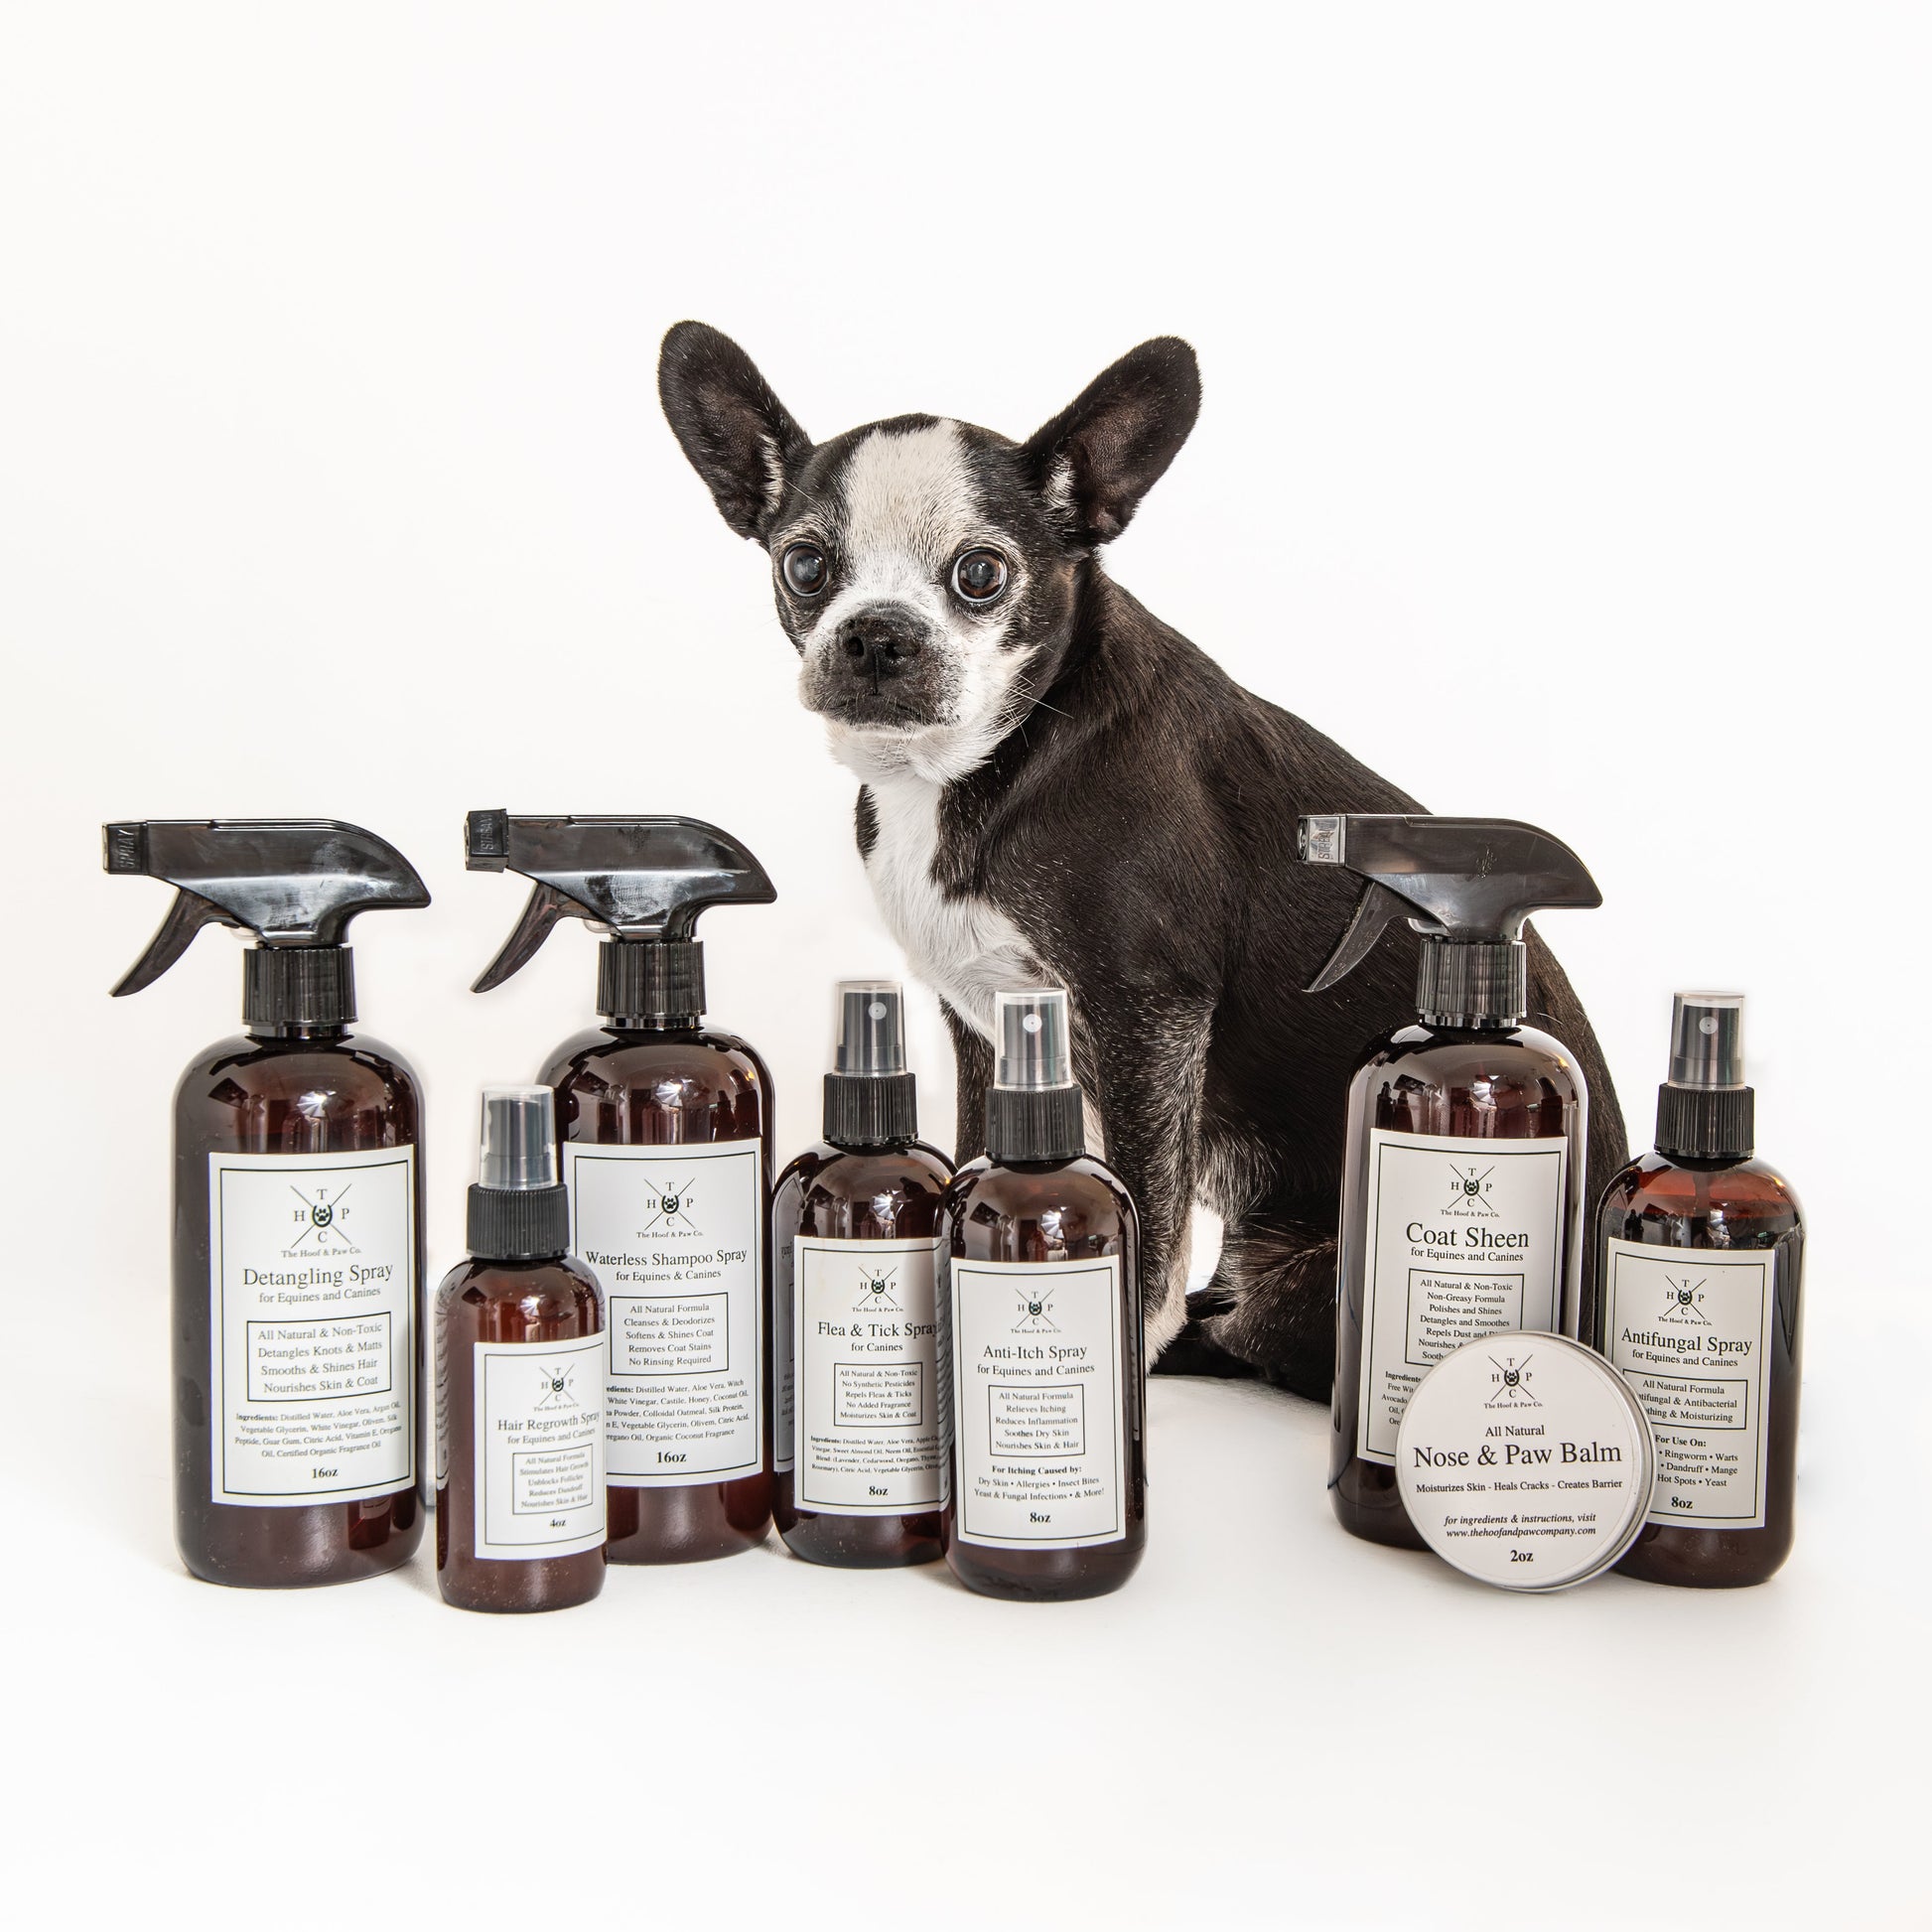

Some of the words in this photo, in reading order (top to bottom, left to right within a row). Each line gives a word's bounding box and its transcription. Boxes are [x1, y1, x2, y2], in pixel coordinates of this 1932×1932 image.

[118, 829, 135, 868] SPRAY
[1406, 1222, 1457, 1246] Coat
[1465, 1227, 1529, 1247] Sheen
[586, 1251, 647, 1266] Waterless
[651, 1254, 713, 1268] Shampoo
[716, 1249, 747, 1265] Spray
[1411, 1247, 1425, 1257] for
[1427, 1249, 1464, 1262] Equines
[1468, 1252, 1485, 1261] and
[243, 1268, 344, 1289] Detangling
[349, 1264, 393, 1282] Spray
[616, 1272, 631, 1281] for
[633, 1271, 670, 1283] Equines
[674, 1271, 682, 1281] &
[686, 1270, 722, 1280] Canines
[1434, 1280, 1462, 1290] Natural
[259, 1293, 273, 1304] for
[278, 1292, 320, 1305] Equines
[323, 1291, 341, 1301] and
[344, 1287, 380, 1300] Canines
[1428, 1293, 1472, 1304] Non-Greasy
[645, 1305, 674, 1313] Natural
[677, 1304, 709, 1312] Formula
[1429, 1305, 1460, 1313] Polishes
[672, 1316, 715, 1325] Deodorizes
[1420, 1315, 1457, 1325] Detangles
[258, 1330, 273, 1340] All
[277, 1329, 316, 1340] Natural
[320, 1328, 328, 1338] &
[333, 1323, 382, 1336] Non-Toxic
[818, 1321, 846, 1336] Flea
[851, 1324, 863, 1336] &
[868, 1323, 899, 1336] Tick
[688, 1342, 712, 1351] Stains
[867, 1342, 903, 1352] Canines
[1621, 1327, 1702, 1352] Antifungal
[1708, 1336, 1753, 1356] Spray
[258, 1347, 310, 1359] Detangles
[314, 1346, 343, 1356] Knots
[345, 1344, 354, 1353] &
[357, 1341, 382, 1352] Matts
[983, 1344, 1043, 1359] Anti-Itch
[1049, 1345, 1087, 1361] Spray
[643, 1357, 674, 1367] Rinsing
[676, 1355, 711, 1365] Required
[1632, 1349, 1644, 1358] for
[1646, 1352, 1680, 1365] Equines
[1683, 1356, 1700, 1365] and
[1702, 1357, 1738, 1366] Canines
[261, 1365, 307, 1376] Smooths
[310, 1364, 319, 1374] &
[323, 1362, 355, 1373] Shines
[357, 1359, 377, 1370] Hair
[977, 1365, 990, 1375] for
[993, 1365, 1032, 1377] Equines
[1035, 1366, 1053, 1376] and
[1056, 1364, 1095, 1375] Canines
[853, 1380, 883, 1389] Synthetic
[1642, 1379, 1655, 1388] All
[1656, 1380, 1688, 1392] Natural
[1690, 1384, 1725, 1394] Formula
[1638, 1392, 1671, 1405] tifungal
[1674, 1396, 1682, 1406] &
[1684, 1397, 1737, 1408] Antibacterial
[1040, 1405, 1066, 1414] Itching
[497, 1420, 523, 1431] Hair
[527, 1414, 579, 1432] Regrowth
[581, 1411, 600, 1424] Spray
[1485, 1426, 1501, 1437] All
[1505, 1425, 1545, 1437] Natural
[507, 1436, 520, 1445] for
[523, 1434, 555, 1446] Equines
[1655, 1435, 1670, 1445] For
[1672, 1437, 1688, 1446] Use
[1690, 1437, 1707, 1448] On:
[656, 1451, 687, 1463] 16oz
[1414, 1447, 1469, 1467] Nose
[1477, 1445, 1498, 1465] &
[1505, 1444, 1553, 1464] Paw
[1561, 1442, 1622, 1463] Balm
[1664, 1449, 1708, 1461] Ringworm
[1716, 1451, 1738, 1461] Warts
[312, 1467, 339, 1479] 16oz
[1008, 1465, 1035, 1475] Itching
[1069, 1465, 1082, 1474] by:
[1667, 1462, 1704, 1473] Dandruff
[1712, 1465, 1737, 1475] Mange
[1417, 1483, 1464, 1492] Moisturizes
[1466, 1482, 1485, 1491] Skin
[1494, 1481, 1517, 1491] Heals
[1520, 1480, 1549, 1490] Cracks
[1557, 1480, 1589, 1489] Creates
[1591, 1479, 1622, 1488] Barrier
[1657, 1474, 1670, 1483] Hot
[1674, 1475, 1696, 1485] Spots
[1705, 1477, 1726, 1487] Yeast
[869, 1486, 888, 1496] 8oz
[1671, 1497, 1693, 1509] 8oz
[550, 1519, 567, 1528] 4oz
[1030, 1512, 1050, 1523] 8oz
[1444, 1515, 1456, 1526] for
[1459, 1514, 1508, 1525] ingredients
[1510, 1514, 1519, 1523] &
[1521, 1514, 1575, 1524] instructions,
[1578, 1513, 1595, 1522] visit
[1446, 1526, 1596, 1538] www.thehoofandpawcompany.com
[1510, 1550, 1534, 1563] 2oz
